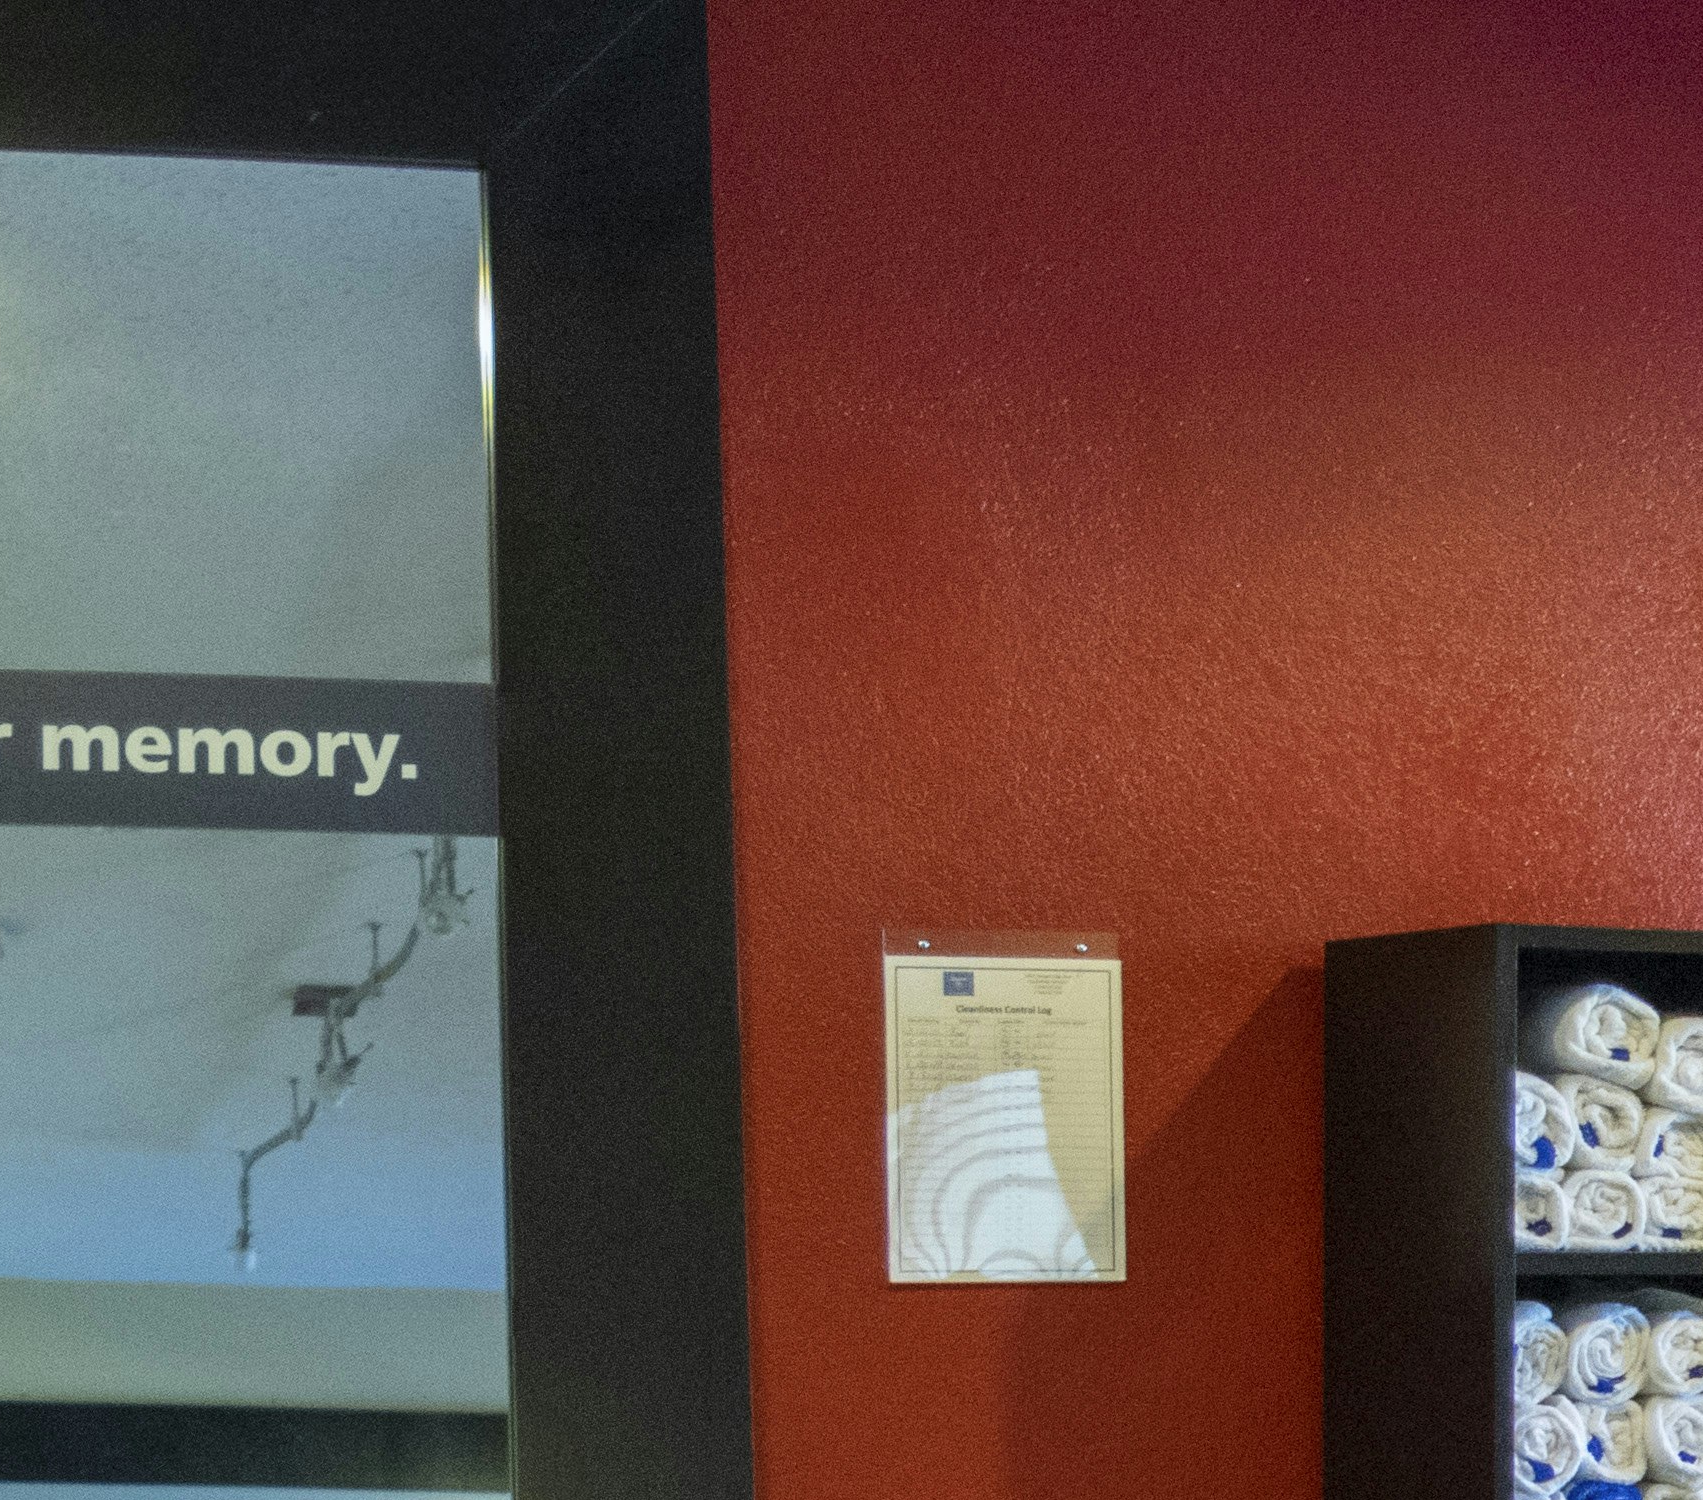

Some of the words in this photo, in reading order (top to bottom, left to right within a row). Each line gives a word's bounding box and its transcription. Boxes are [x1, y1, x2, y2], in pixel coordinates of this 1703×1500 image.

[42, 724, 418, 797] memory.
[956, 1004, 1002, 1014] Cleanliness
[1004, 1005, 1036, 1014] Control
[1037, 1006, 1052, 1016] Log
